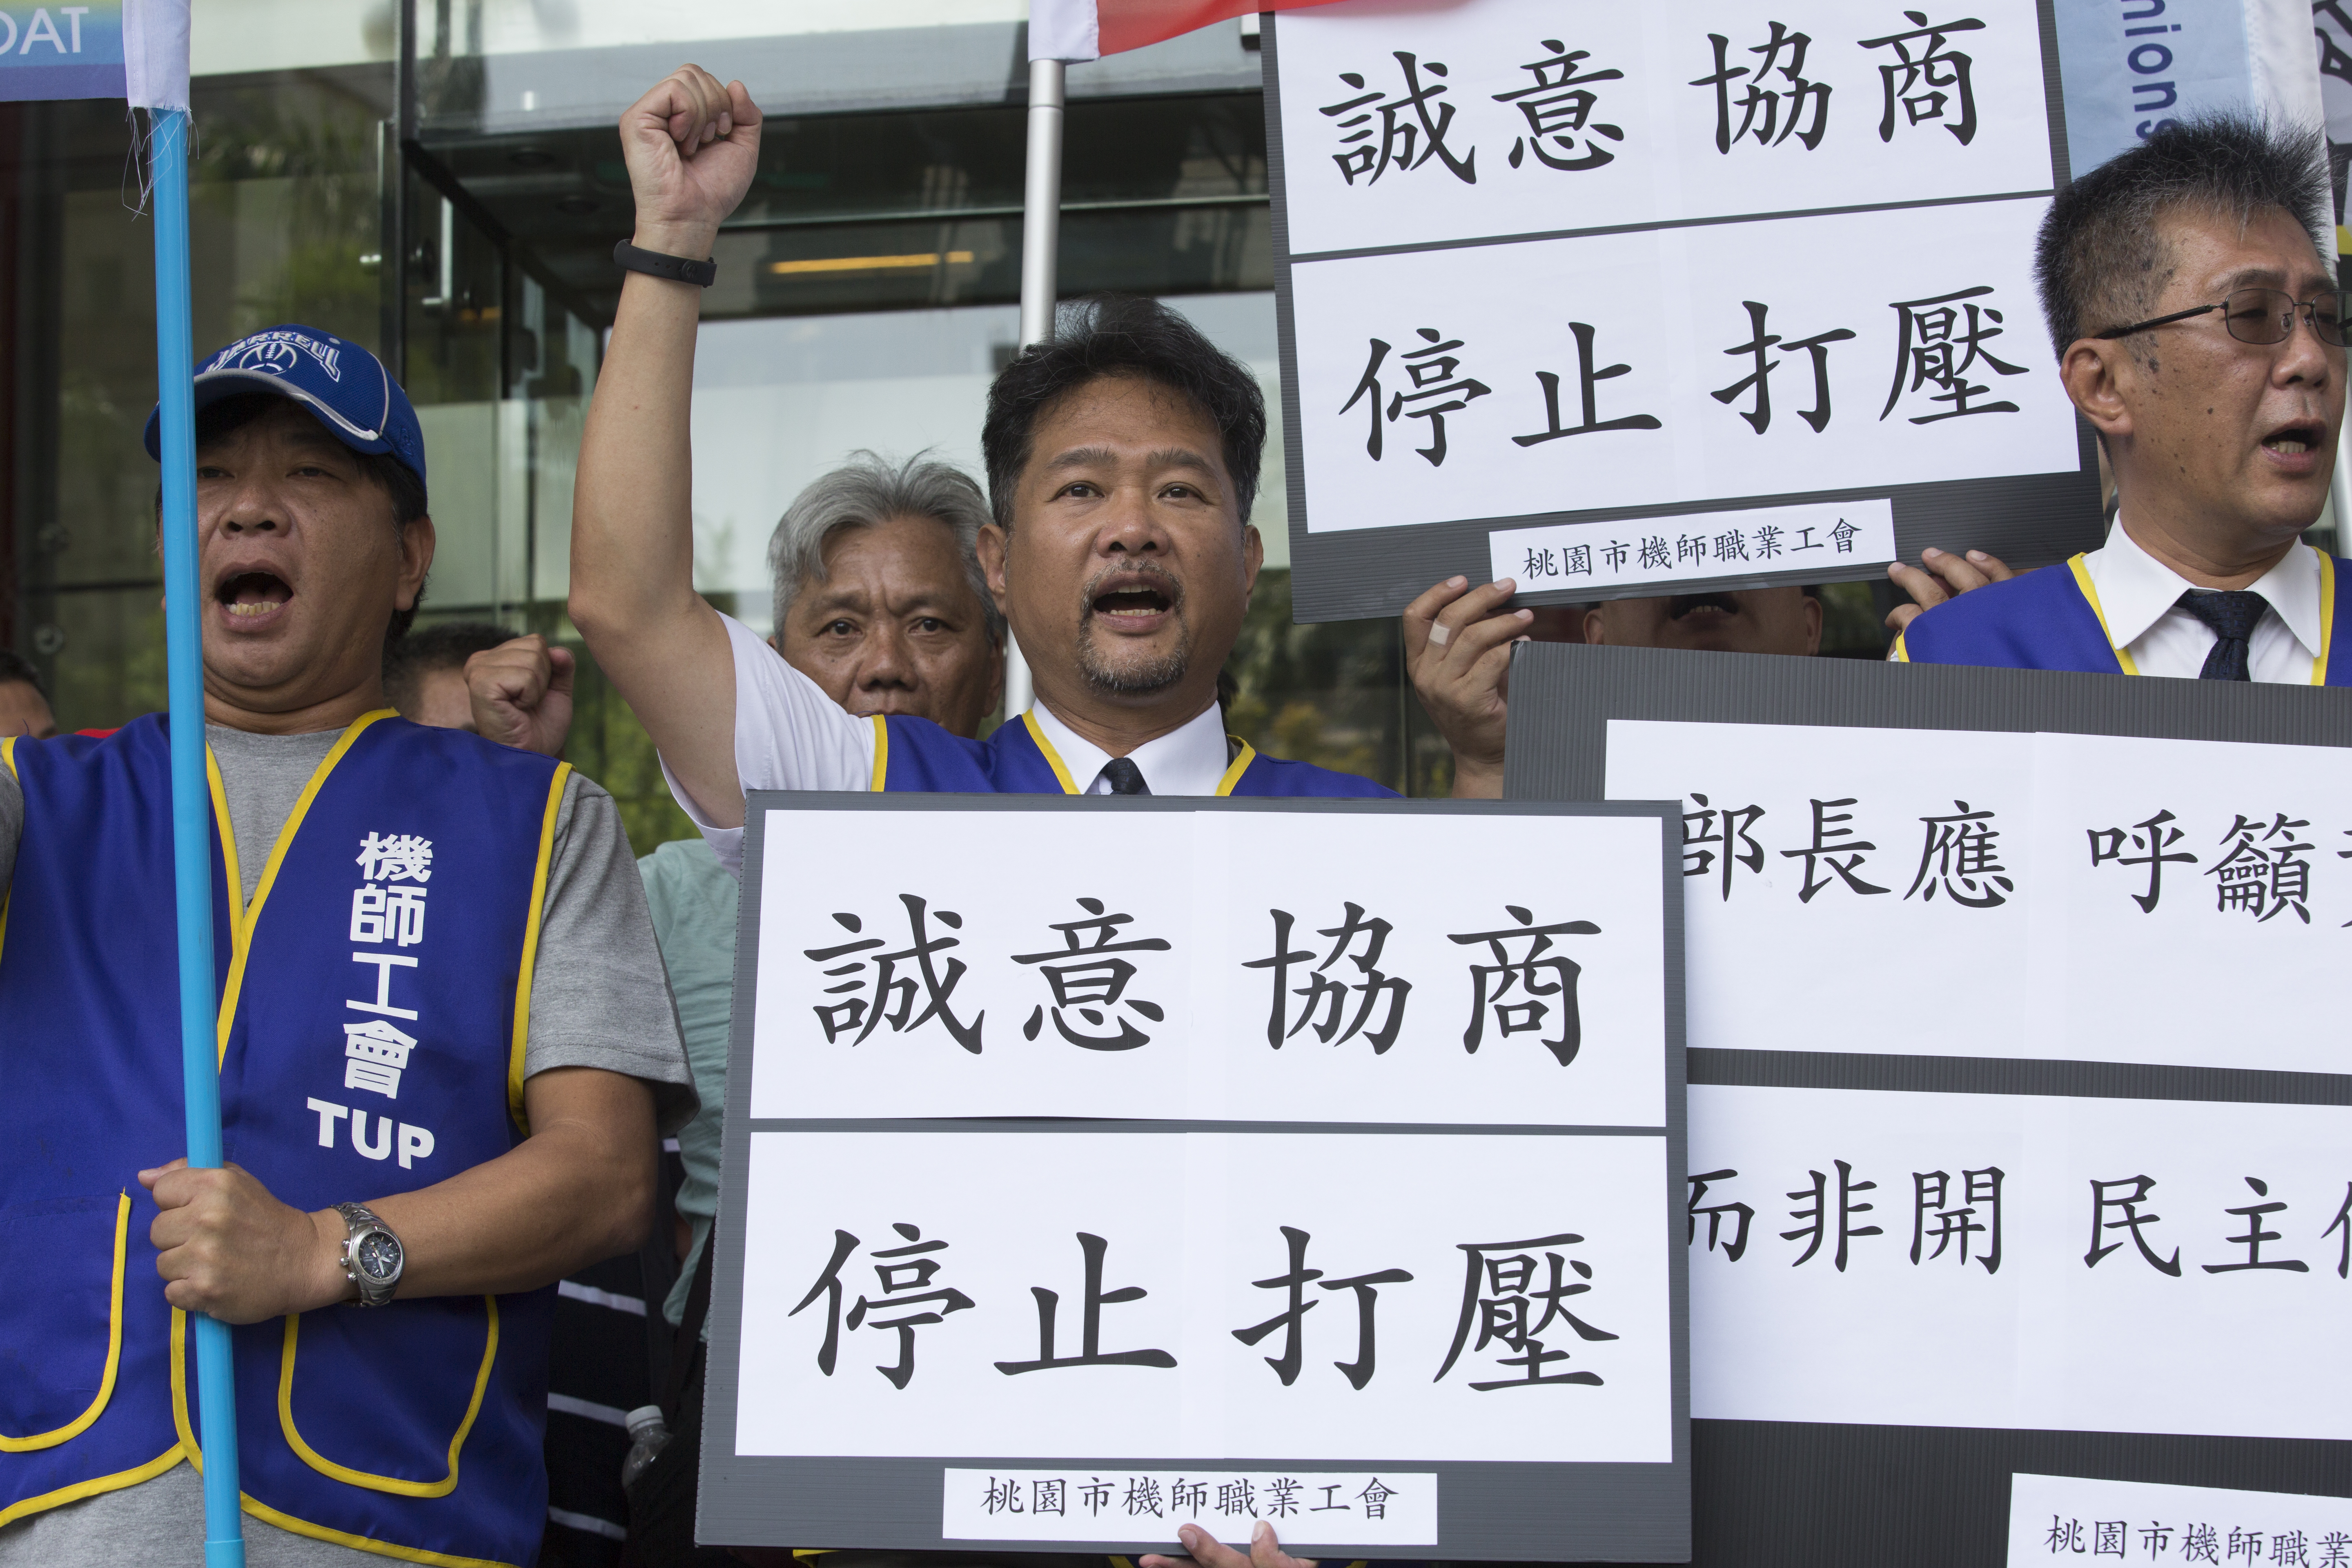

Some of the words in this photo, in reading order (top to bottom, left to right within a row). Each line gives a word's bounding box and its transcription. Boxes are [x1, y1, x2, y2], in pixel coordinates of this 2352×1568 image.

[1522, 518, 1862, 580] 桃園市機師職業工會
[343, 832, 433, 1099] 機師工會
[307, 1097, 434, 1169] TUP
[982, 1477, 1398, 1519] 桃園市機師職業工會
